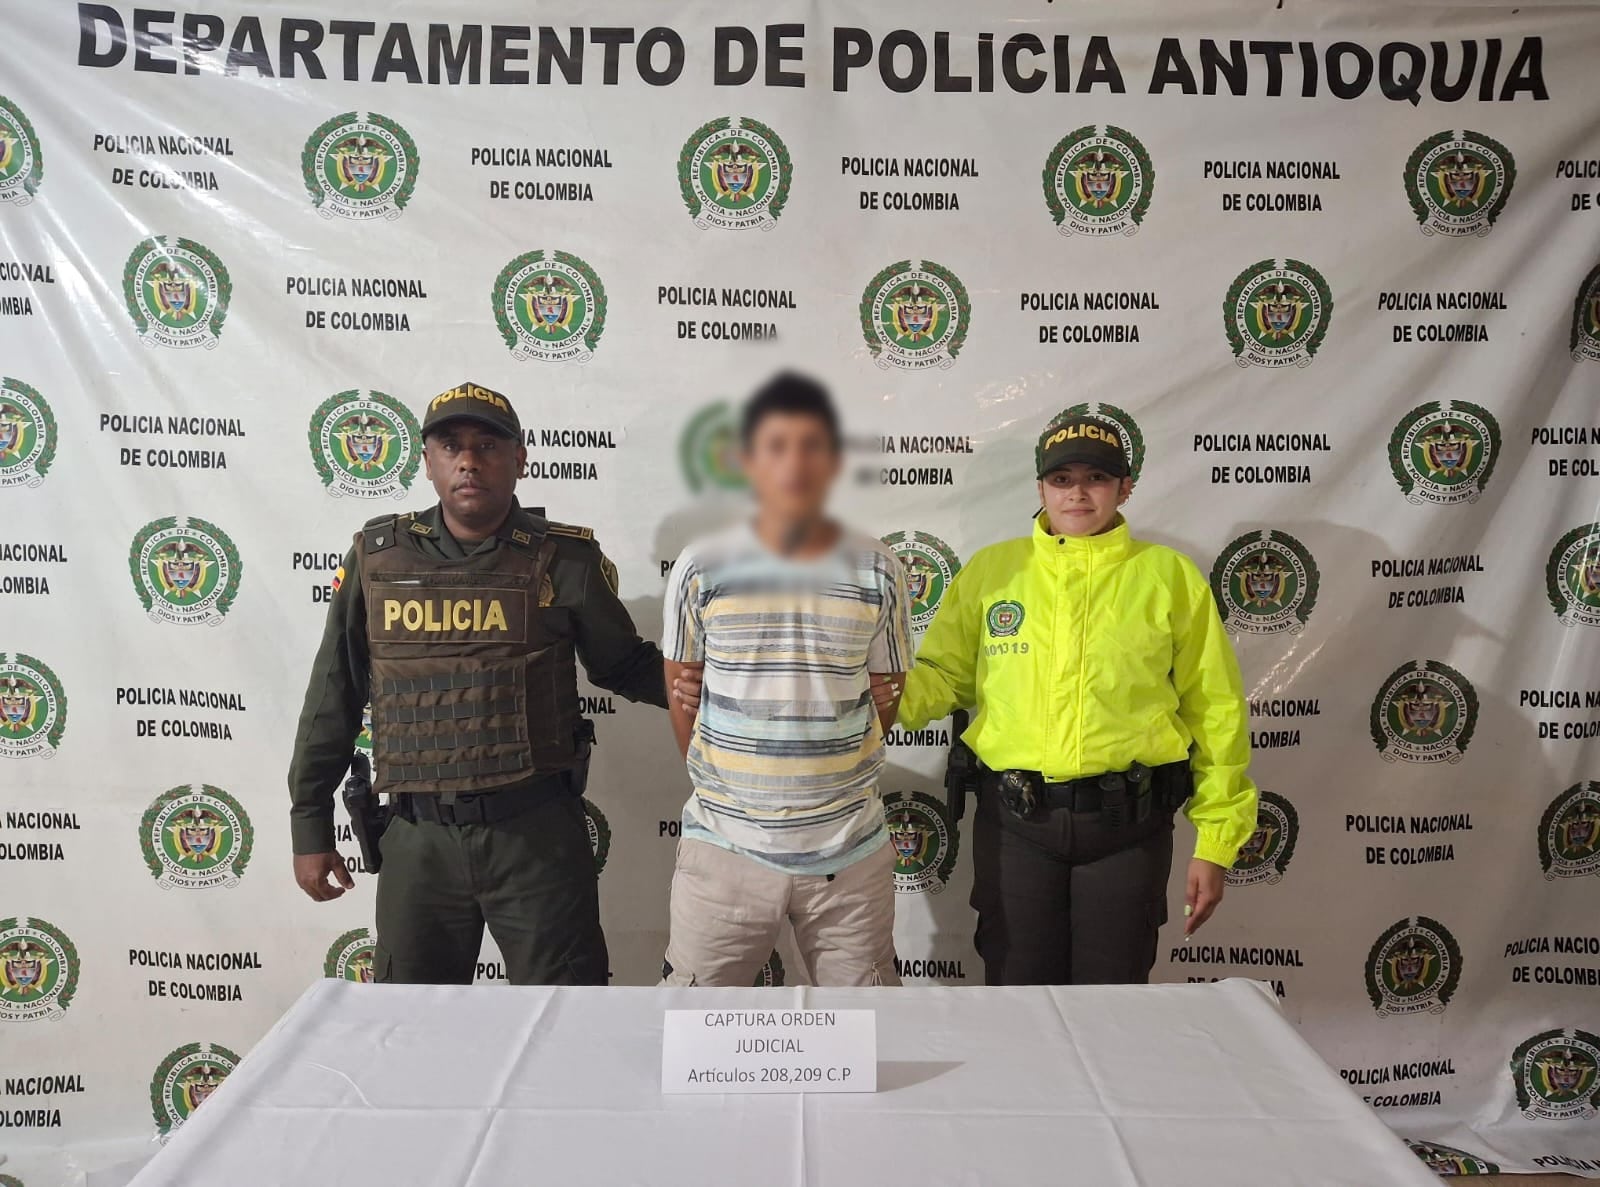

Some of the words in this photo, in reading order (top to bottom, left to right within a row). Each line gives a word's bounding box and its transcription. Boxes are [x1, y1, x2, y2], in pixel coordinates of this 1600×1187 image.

[79, 3, 684, 86] DEPARTAMENTO
[714, 24, 805, 89] DE
[833, 27, 1126, 94] POLICIA
[1148, 36, 1550, 107] ANTIOQUIA
[94, 134, 154, 155] POLICIA
[158, 137, 234, 156] NACIONAL
[472, 148, 531, 166] POLICIA
[536, 149, 612, 167] NACIONAL
[752, 135, 778, 181] COLOMBIA
[842, 157, 899, 176] POLICIA
[905, 159, 978, 176] NACIONAL
[1205, 161, 1261, 178] POLICIA
[1267, 162, 1340, 179] NACIONAL
[1556, 160, 1600, 178] POLICI
[112, 168, 134, 186] DE
[140, 170, 218, 190] COLOMBIA
[491, 181, 509, 198] DE
[515, 182, 593, 201] COLOMBIA
[735, 191, 773, 217] NACIONAL
[860, 192, 878, 209] DE
[883, 192, 959, 210] COLOMBIA
[1223, 194, 1241, 210] DE
[1246, 194, 1322, 211] COLOMBIA
[1571, 194, 1591, 211] DE
[0, 263, 54, 283] CIONAL
[287, 277, 347, 296] POLICIA
[352, 279, 427, 298] NACIONAL
[566, 268, 593, 313] COLOMBIA
[659, 287, 717, 306] POLICIA
[722, 289, 796, 308] NACIONAL
[1021, 293, 1079, 310] POLICIA
[1084, 293, 1159, 310] NACIONAL
[1296, 276, 1321, 320] COLOMBIA
[1378, 293, 1432, 310] POLICIA
[1437, 292, 1507, 309] NACIONAL
[306, 311, 325, 328] DE
[331, 312, 410, 331] COLOMBIA
[678, 321, 696, 339] DE
[702, 322, 776, 340] COLOMBIA
[552, 323, 590, 348] NACIONAL
[1040, 326, 1057, 343] DE
[1063, 325, 1139, 343] COLOMBIA
[1275, 329, 1313, 354] NACIONAL
[1394, 326, 1412, 342] DE
[1417, 325, 1488, 342] COLOMBIA
[431, 383, 508, 412] POLICIA
[101, 414, 163, 433] POLICIA
[169, 417, 245, 436] NACIONAL
[542, 430, 616, 448] NACIONAL
[901, 436, 973, 453] NACIONAL
[1045, 424, 1118, 449] POLICIA
[1194, 435, 1251, 451] POLICIA
[1256, 434, 1330, 451] NACIONAL
[1531, 428, 1587, 445] POLICIA
[121, 448, 141, 466] DE
[147, 449, 226, 469] COLOMBIA
[1549, 459, 1567, 476] DE
[1212, 467, 1230, 483] DE
[1235, 466, 1310, 483] COLOMBIA
[293, 553, 342, 571] POLICI
[1372, 560, 1424, 577] POLICIA
[1428, 555, 1483, 575] NACIONAL
[313, 586, 331, 603] DE
[1389, 592, 1404, 608] DE
[1407, 587, 1464, 607] COLOMBIA
[384, 599, 507, 632] POLICIA
[117, 688, 176, 705] POLICIA
[180, 690, 245, 711] NACIONAL
[1438, 677, 1465, 718] COLOMBIA
[1520, 690, 1580, 708] POLICIA
[1251, 699, 1320, 717] NACIONAL
[137, 720, 156, 736] DE
[162, 720, 232, 740] COLOMBIA
[885, 730, 949, 747] OLOMBIA
[1251, 730, 1300, 748] LOMBIA
[1423, 728, 1461, 751] NACIONAL
[1539, 722, 1558, 739] DE
[7, 812, 80, 829] NACIONAL
[213, 801, 240, 842] COLOMBIA
[1346, 815, 1406, 833] POLICIA
[1411, 814, 1472, 833] NACIONAL
[1366, 847, 1385, 864] DE
[1390, 845, 1454, 864] COLOMBIA
[199, 853, 237, 876] NACIONAL
[1171, 946, 1225, 963] POLICIA
[1230, 947, 1303, 966] NACIONAL
[1504, 937, 1549, 957] POLICIA
[1555, 937, 1599, 954] NACIO
[130, 950, 182, 968] POLICIA
[187, 952, 261, 970] NACIONAL
[1513, 967, 1530, 982] DE
[149, 980, 166, 996] DE
[171, 982, 242, 1001] COLOMBIA
[705, 1013, 776, 1027] CAPTURA
[781, 1012, 835, 1026] ORDEN
[736, 1039, 804, 1053] JUDICIAL
[687, 1067, 755, 1082] Artículos
[760, 1067, 822, 1084] 208,209
[827, 1067, 851, 1081] C.P
[1393, 1059, 1455, 1081] NACIONAL
[6, 1075, 85, 1095] NACIONAL
[1374, 1091, 1441, 1107] COLOMBIA
